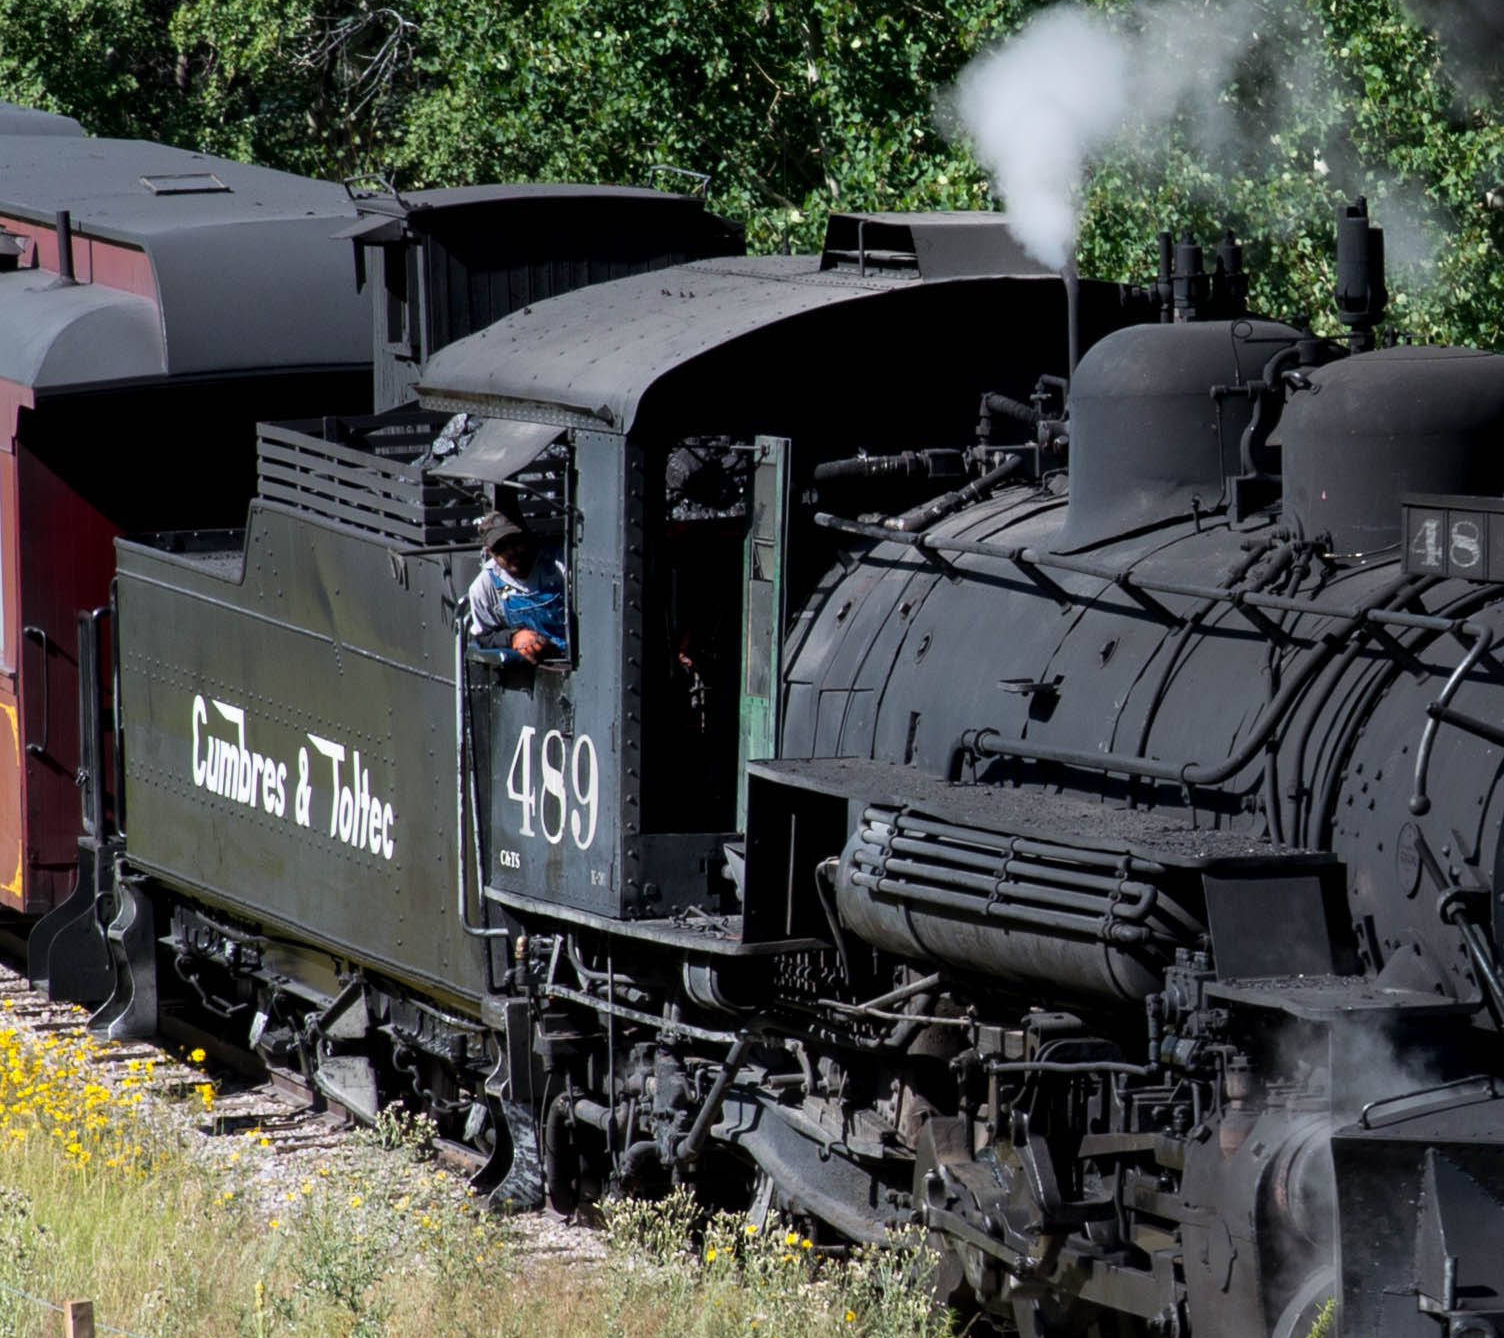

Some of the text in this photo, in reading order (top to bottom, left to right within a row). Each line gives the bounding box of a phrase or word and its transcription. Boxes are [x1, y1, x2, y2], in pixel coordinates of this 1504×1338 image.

[1409, 517, 1482, 570] 48
[192, 694, 395, 861] Cumbres & Toltec
[506, 725, 599, 851] 489
